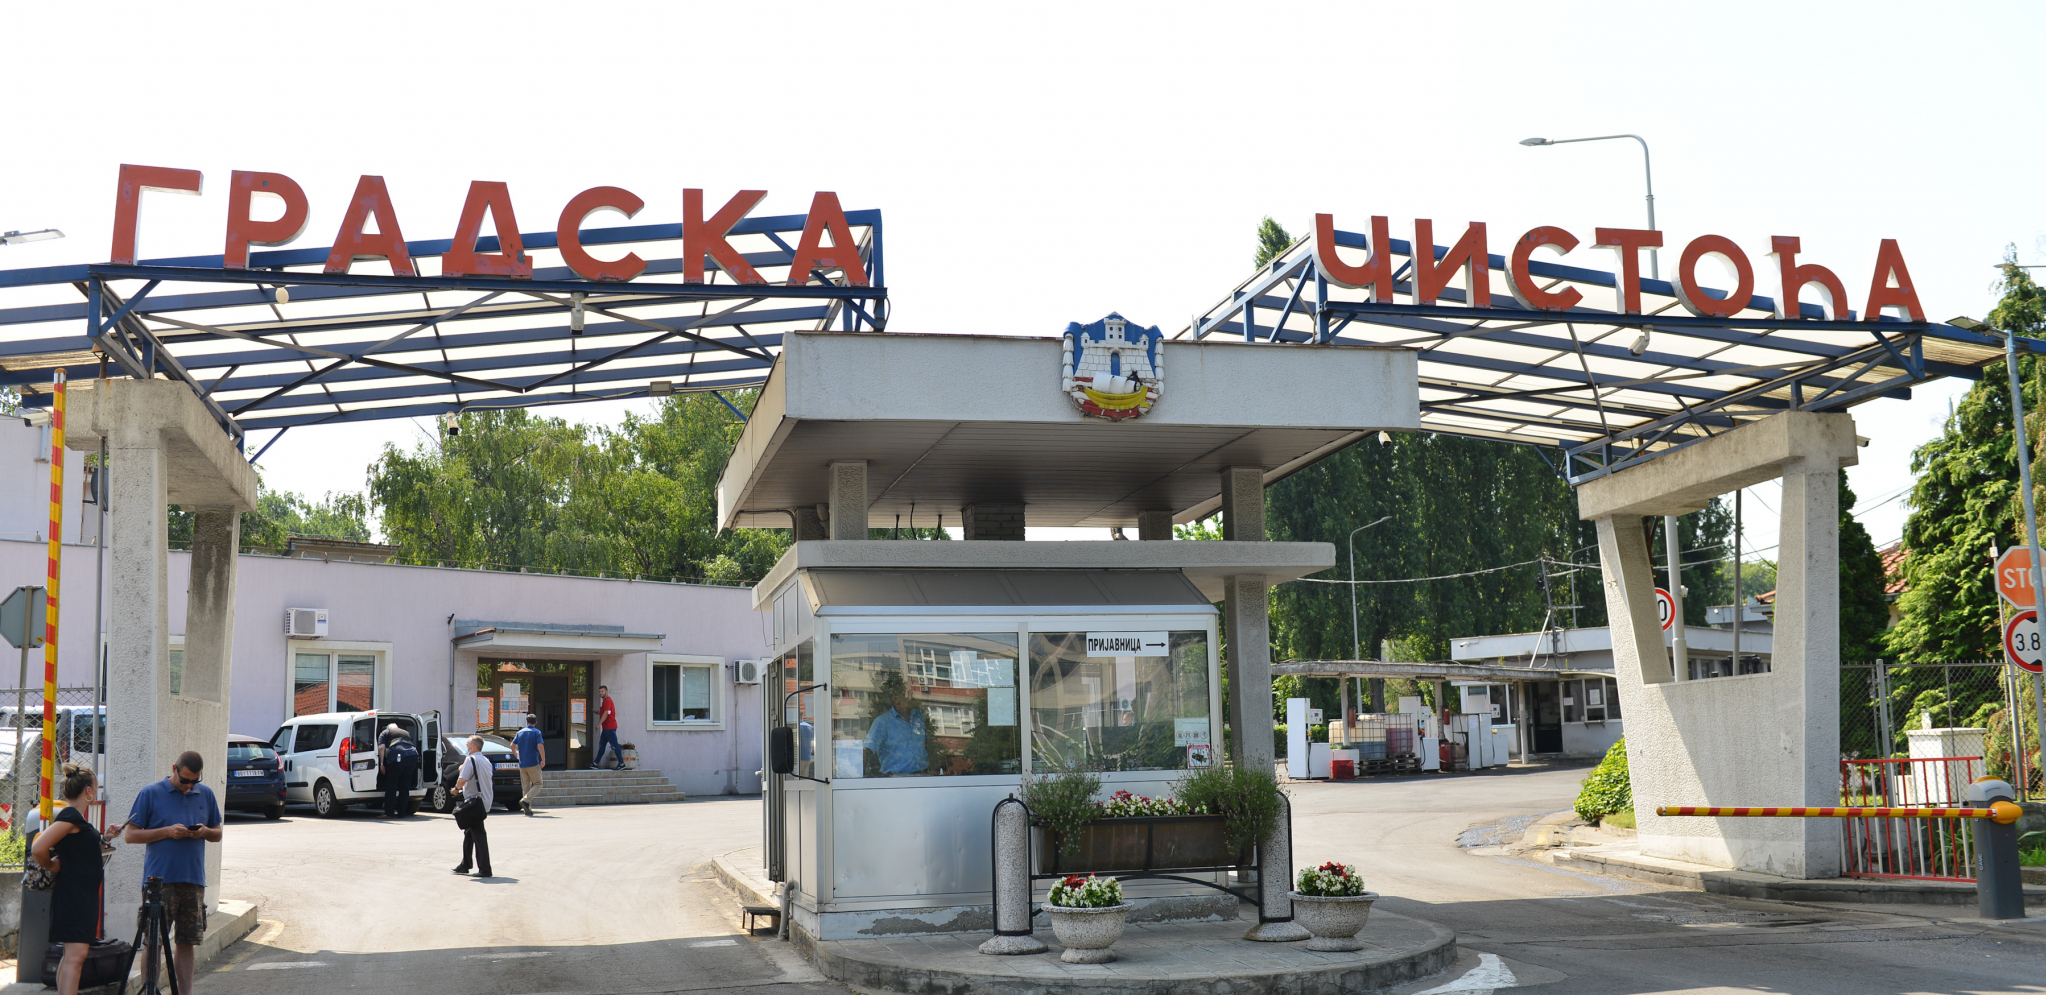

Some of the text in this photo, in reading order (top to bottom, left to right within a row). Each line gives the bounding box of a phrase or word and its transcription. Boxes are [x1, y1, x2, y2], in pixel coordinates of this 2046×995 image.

[110, 163, 871, 287] ГРАДСКА
[1309, 213, 1927, 322] ЧИСТОЋА
[1657, 599, 1668, 621] 0
[1088, 638, 1142, 654] ПРИЈАВНИЦА
[2014, 632, 2041, 651] 3.8
